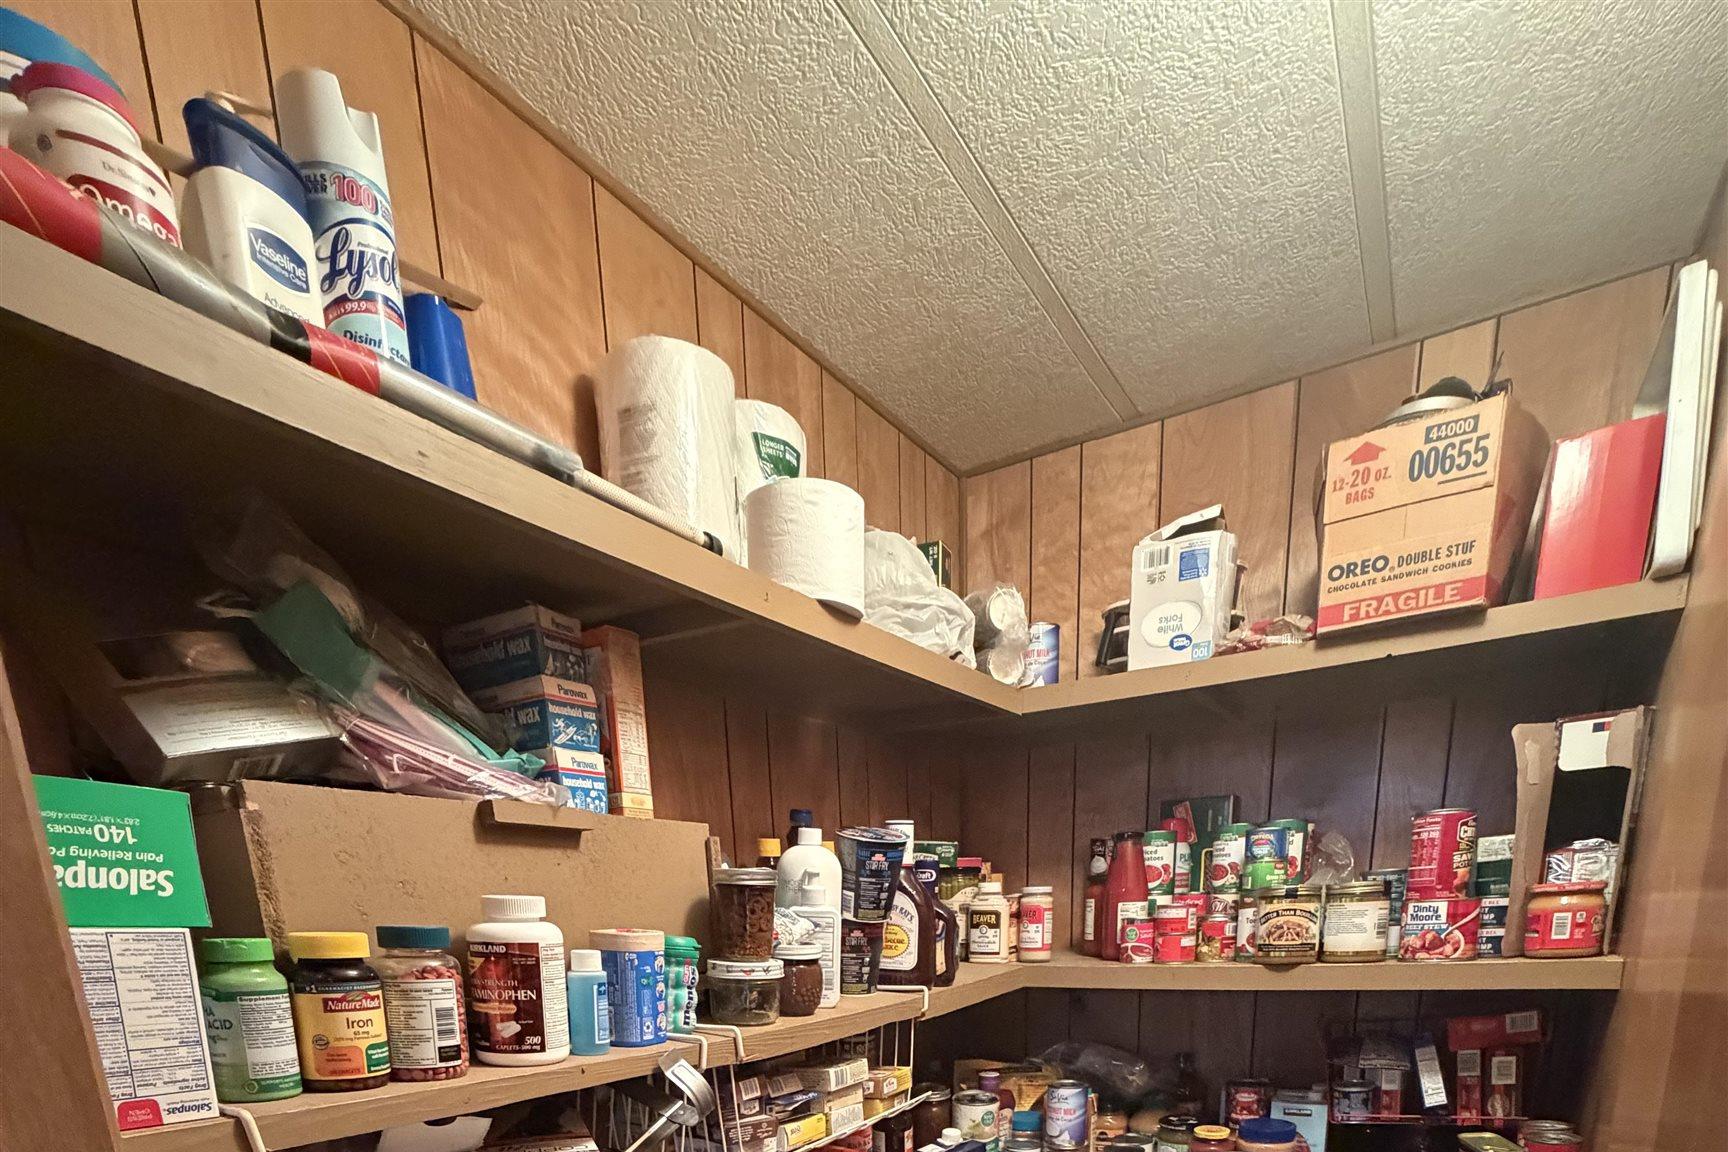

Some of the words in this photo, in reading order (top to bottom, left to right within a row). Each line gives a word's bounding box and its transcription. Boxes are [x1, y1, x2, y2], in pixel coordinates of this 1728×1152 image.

[330, 172, 379, 214] 100
[250, 233, 306, 281] Vaseline
[315, 227, 402, 297] Lysol
[1429, 418, 1475, 441] 44000
[1408, 433, 1491, 482] 00655
[1332, 467, 1371, 493] 12-20
[1345, 487, 1375, 505] BAGS
[1327, 555, 1390, 582] OREO
[1397, 546, 1441, 569] DOUBLE
[1446, 540, 1476, 558] STUF
[1327, 576, 1378, 594] CHOCOLATE
[1381, 567, 1428, 583] SANDWICH
[1432, 557, 1473, 574] COOKIES
[1343, 582, 1464, 622] FRAGILE
[1158, 613, 1183, 624] Forks
[1157, 623, 1183, 634] White
[1193, 645, 1209, 659] 100
[558, 684, 588, 700] Parowax
[571, 757, 598, 771] Parowax
[562, 776, 593, 788] household
[593, 778, 605, 790] wax
[46, 823, 92, 835] PATCHES
[94, 823, 137, 844] 140
[70, 845, 132, 862] Relieving
[136, 851, 164, 863] Pain
[1144, 848, 1158, 856] iced
[53, 860, 174, 897] Salonpa
[916, 871, 931, 880] raft
[1413, 904, 1439, 913] Dinty
[973, 914, 996, 924] BEAVER
[1409, 913, 1442, 922] Moore
[470, 944, 506, 953] KIRKLAND
[683, 966, 696, 1026] mentos
[208, 1020, 233, 1030] ACID
[346, 1017, 373, 1029] Iron
[524, 1036, 541, 1045] 500
[165, 1102, 212, 1117] Salonpas
